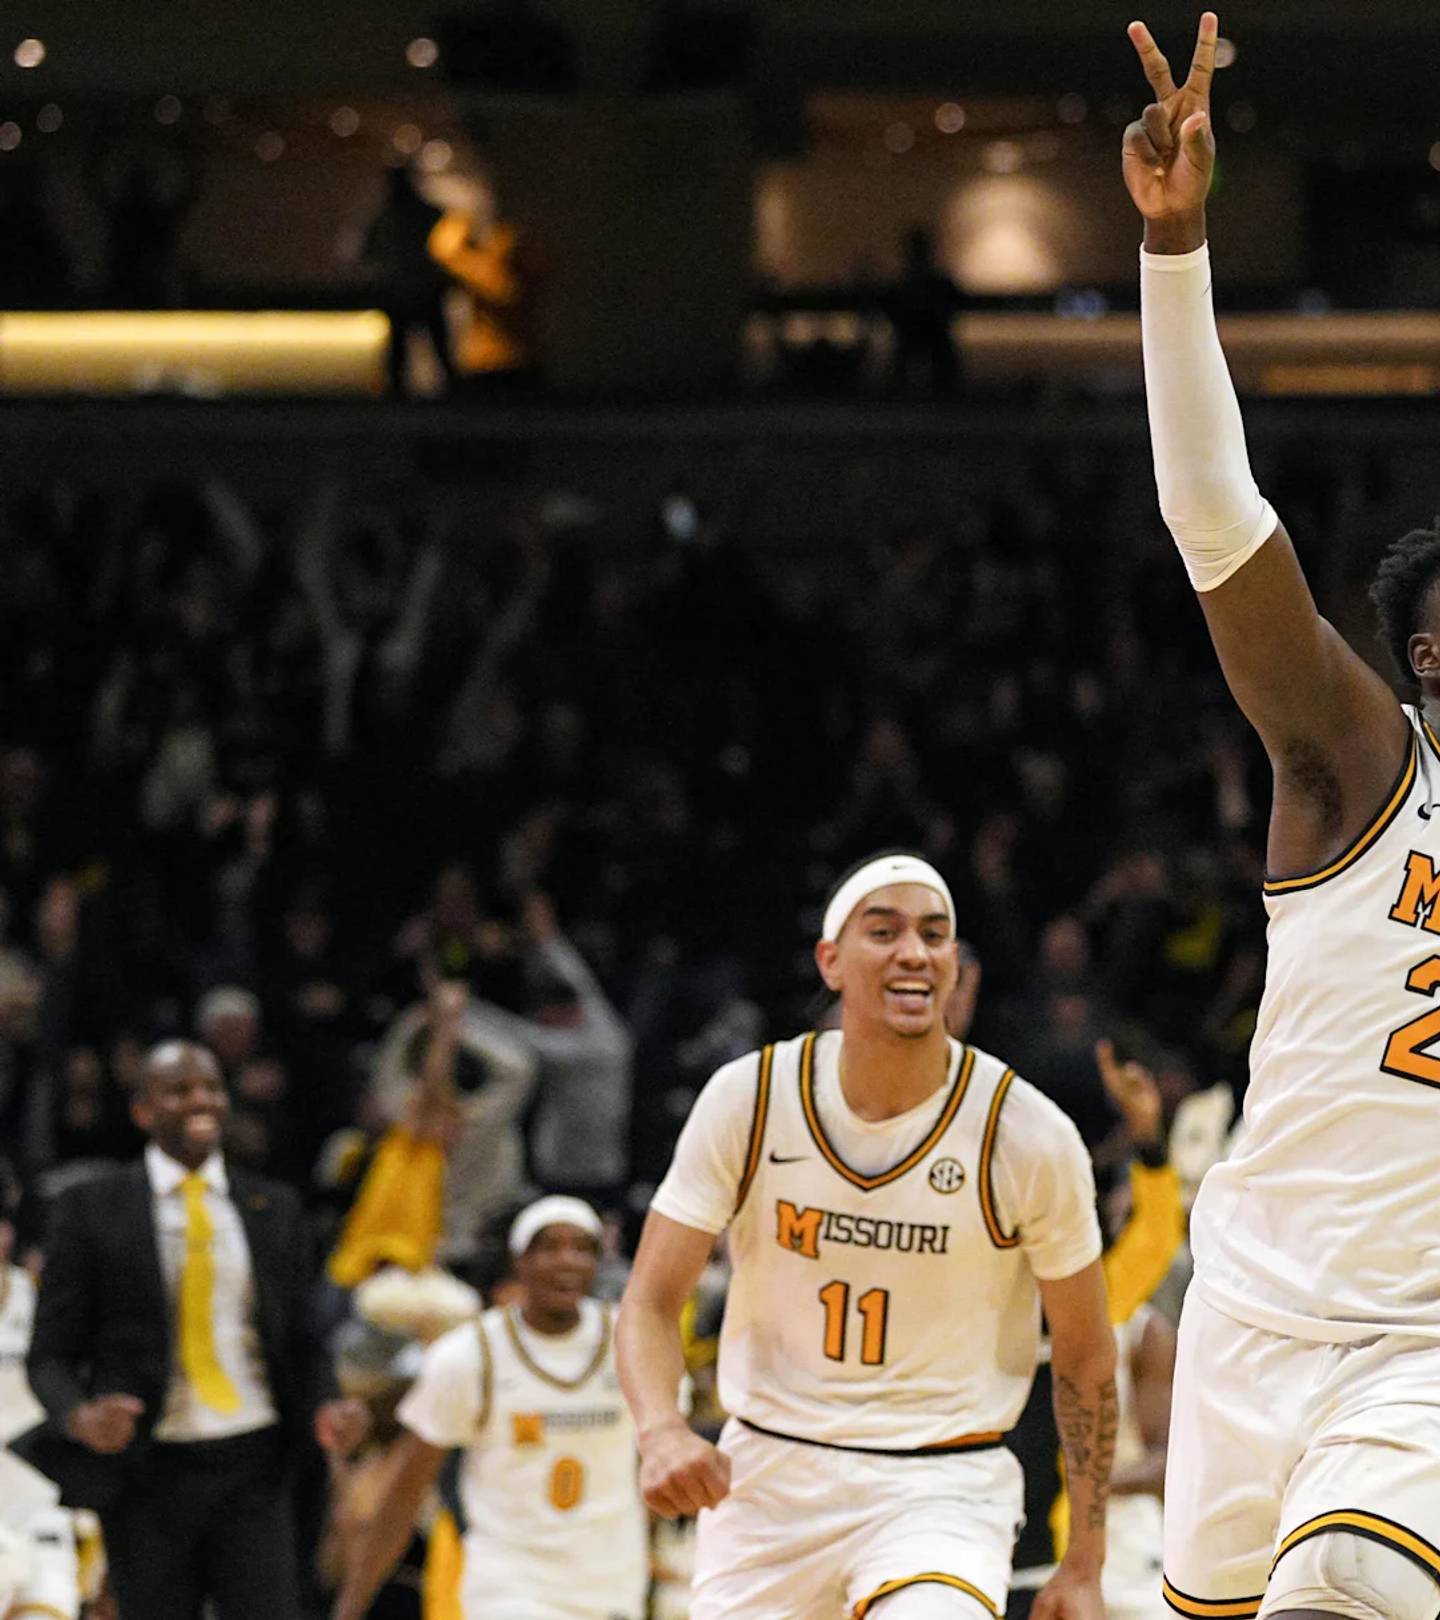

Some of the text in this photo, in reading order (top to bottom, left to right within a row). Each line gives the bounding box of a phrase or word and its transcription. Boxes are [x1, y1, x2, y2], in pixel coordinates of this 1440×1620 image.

[776, 1200, 950, 1260] MISSOURI
[819, 1279, 889, 1365] 11
[548, 1456, 584, 1512] 0
